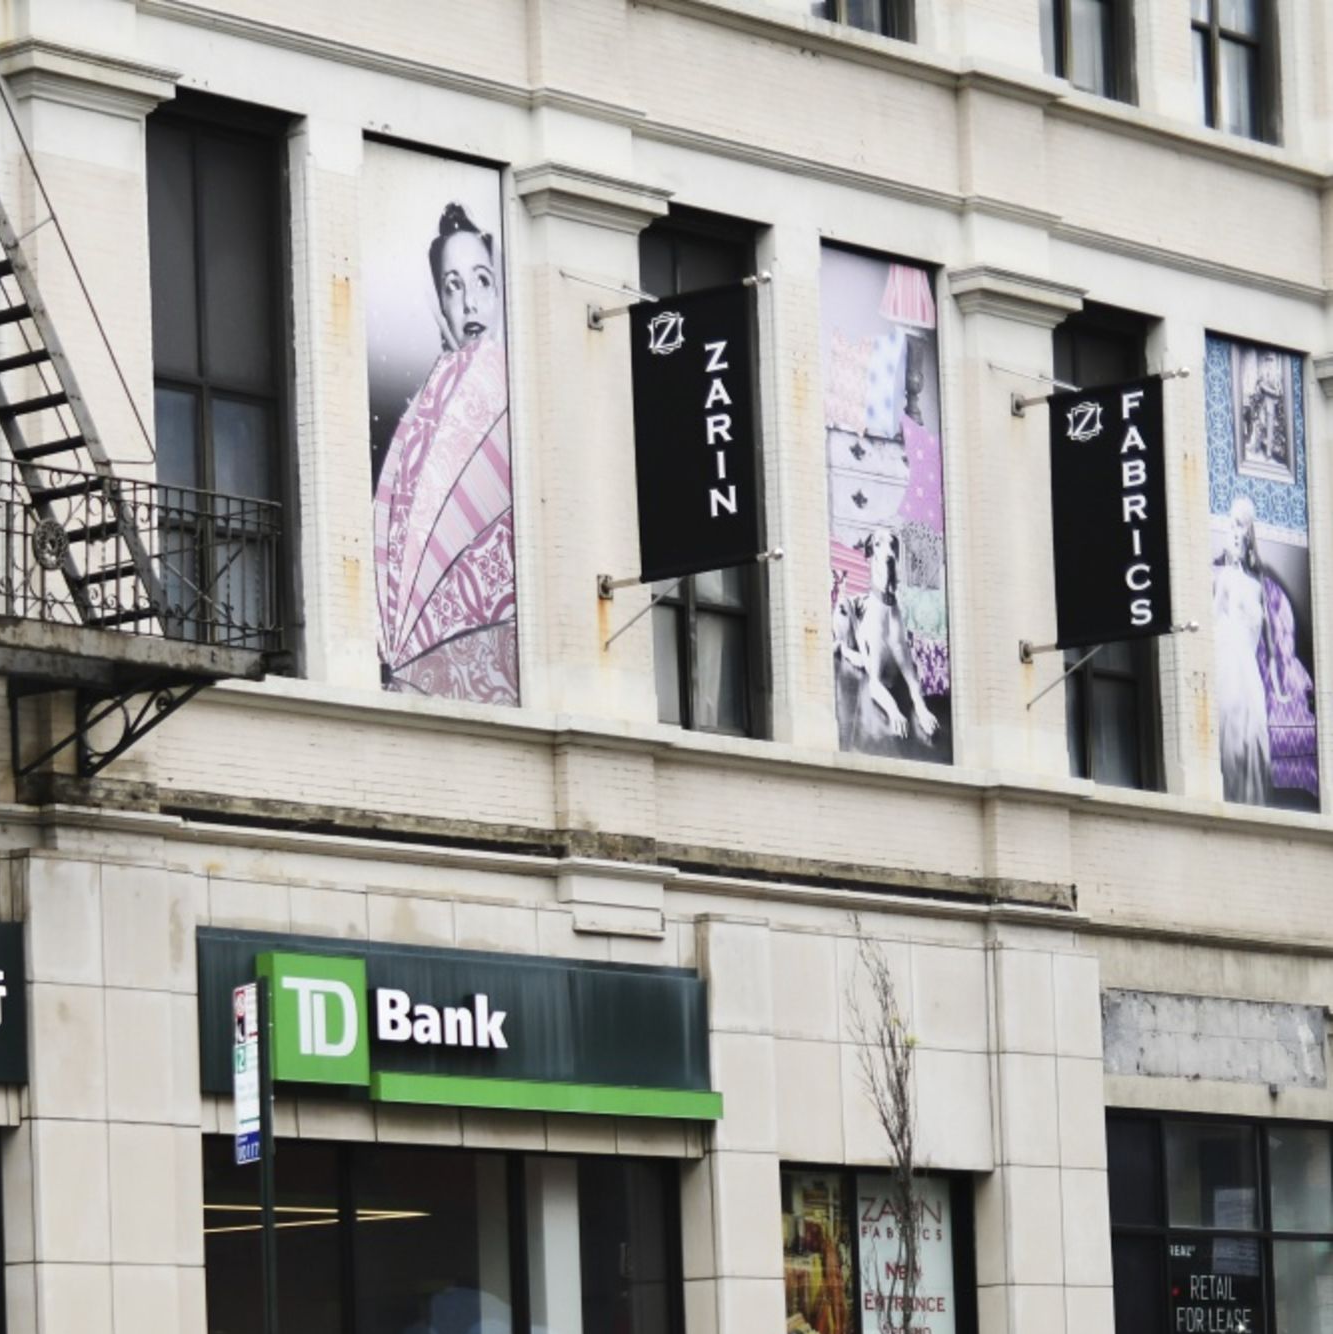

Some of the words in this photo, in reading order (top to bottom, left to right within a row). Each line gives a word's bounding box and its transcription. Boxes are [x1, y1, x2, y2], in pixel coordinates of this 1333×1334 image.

[705, 341, 737, 518] ZARIN
[1120, 392, 1152, 627] FABRICS
[281, 976, 358, 1057] TD
[376, 987, 508, 1049] Bank
[859, 1197, 942, 1224] ZAN
[1190, 1274, 1236, 1300] RETAIL
[864, 1293, 946, 1312] ENTRNCE
[1176, 1306, 1205, 1333] FOR
[1208, 1307, 1252, 1334] LEASE
